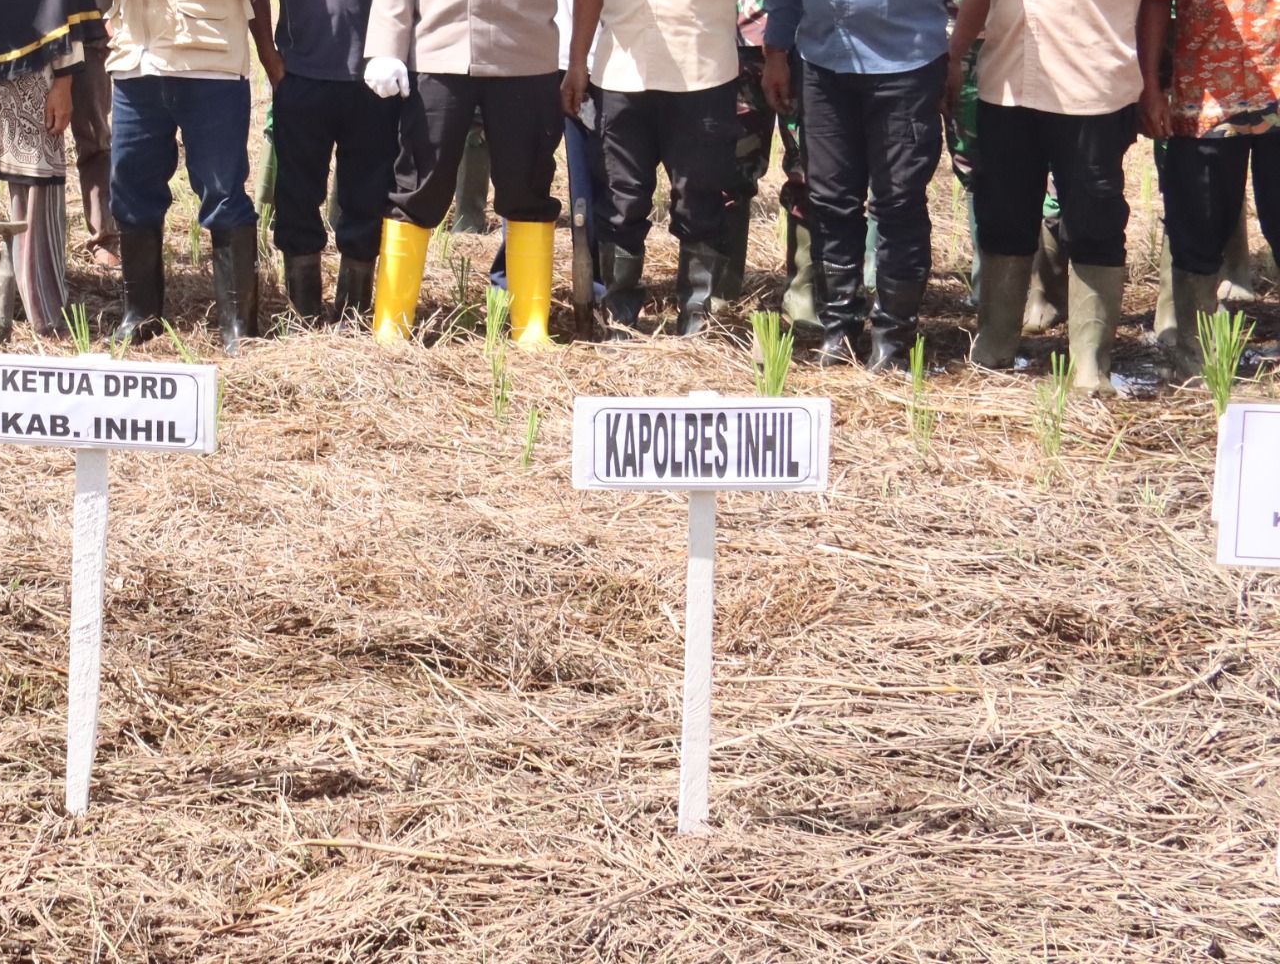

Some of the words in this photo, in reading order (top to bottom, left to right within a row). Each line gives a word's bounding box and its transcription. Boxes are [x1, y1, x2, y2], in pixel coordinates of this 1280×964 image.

[1, 369, 94, 396] KETUA
[104, 374, 178, 400] DPRD
[1, 411, 81, 438] KAB.
[94, 417, 186, 444] INHIL
[605, 411, 729, 479] KAPOLRES
[736, 412, 799, 478] INHIL
